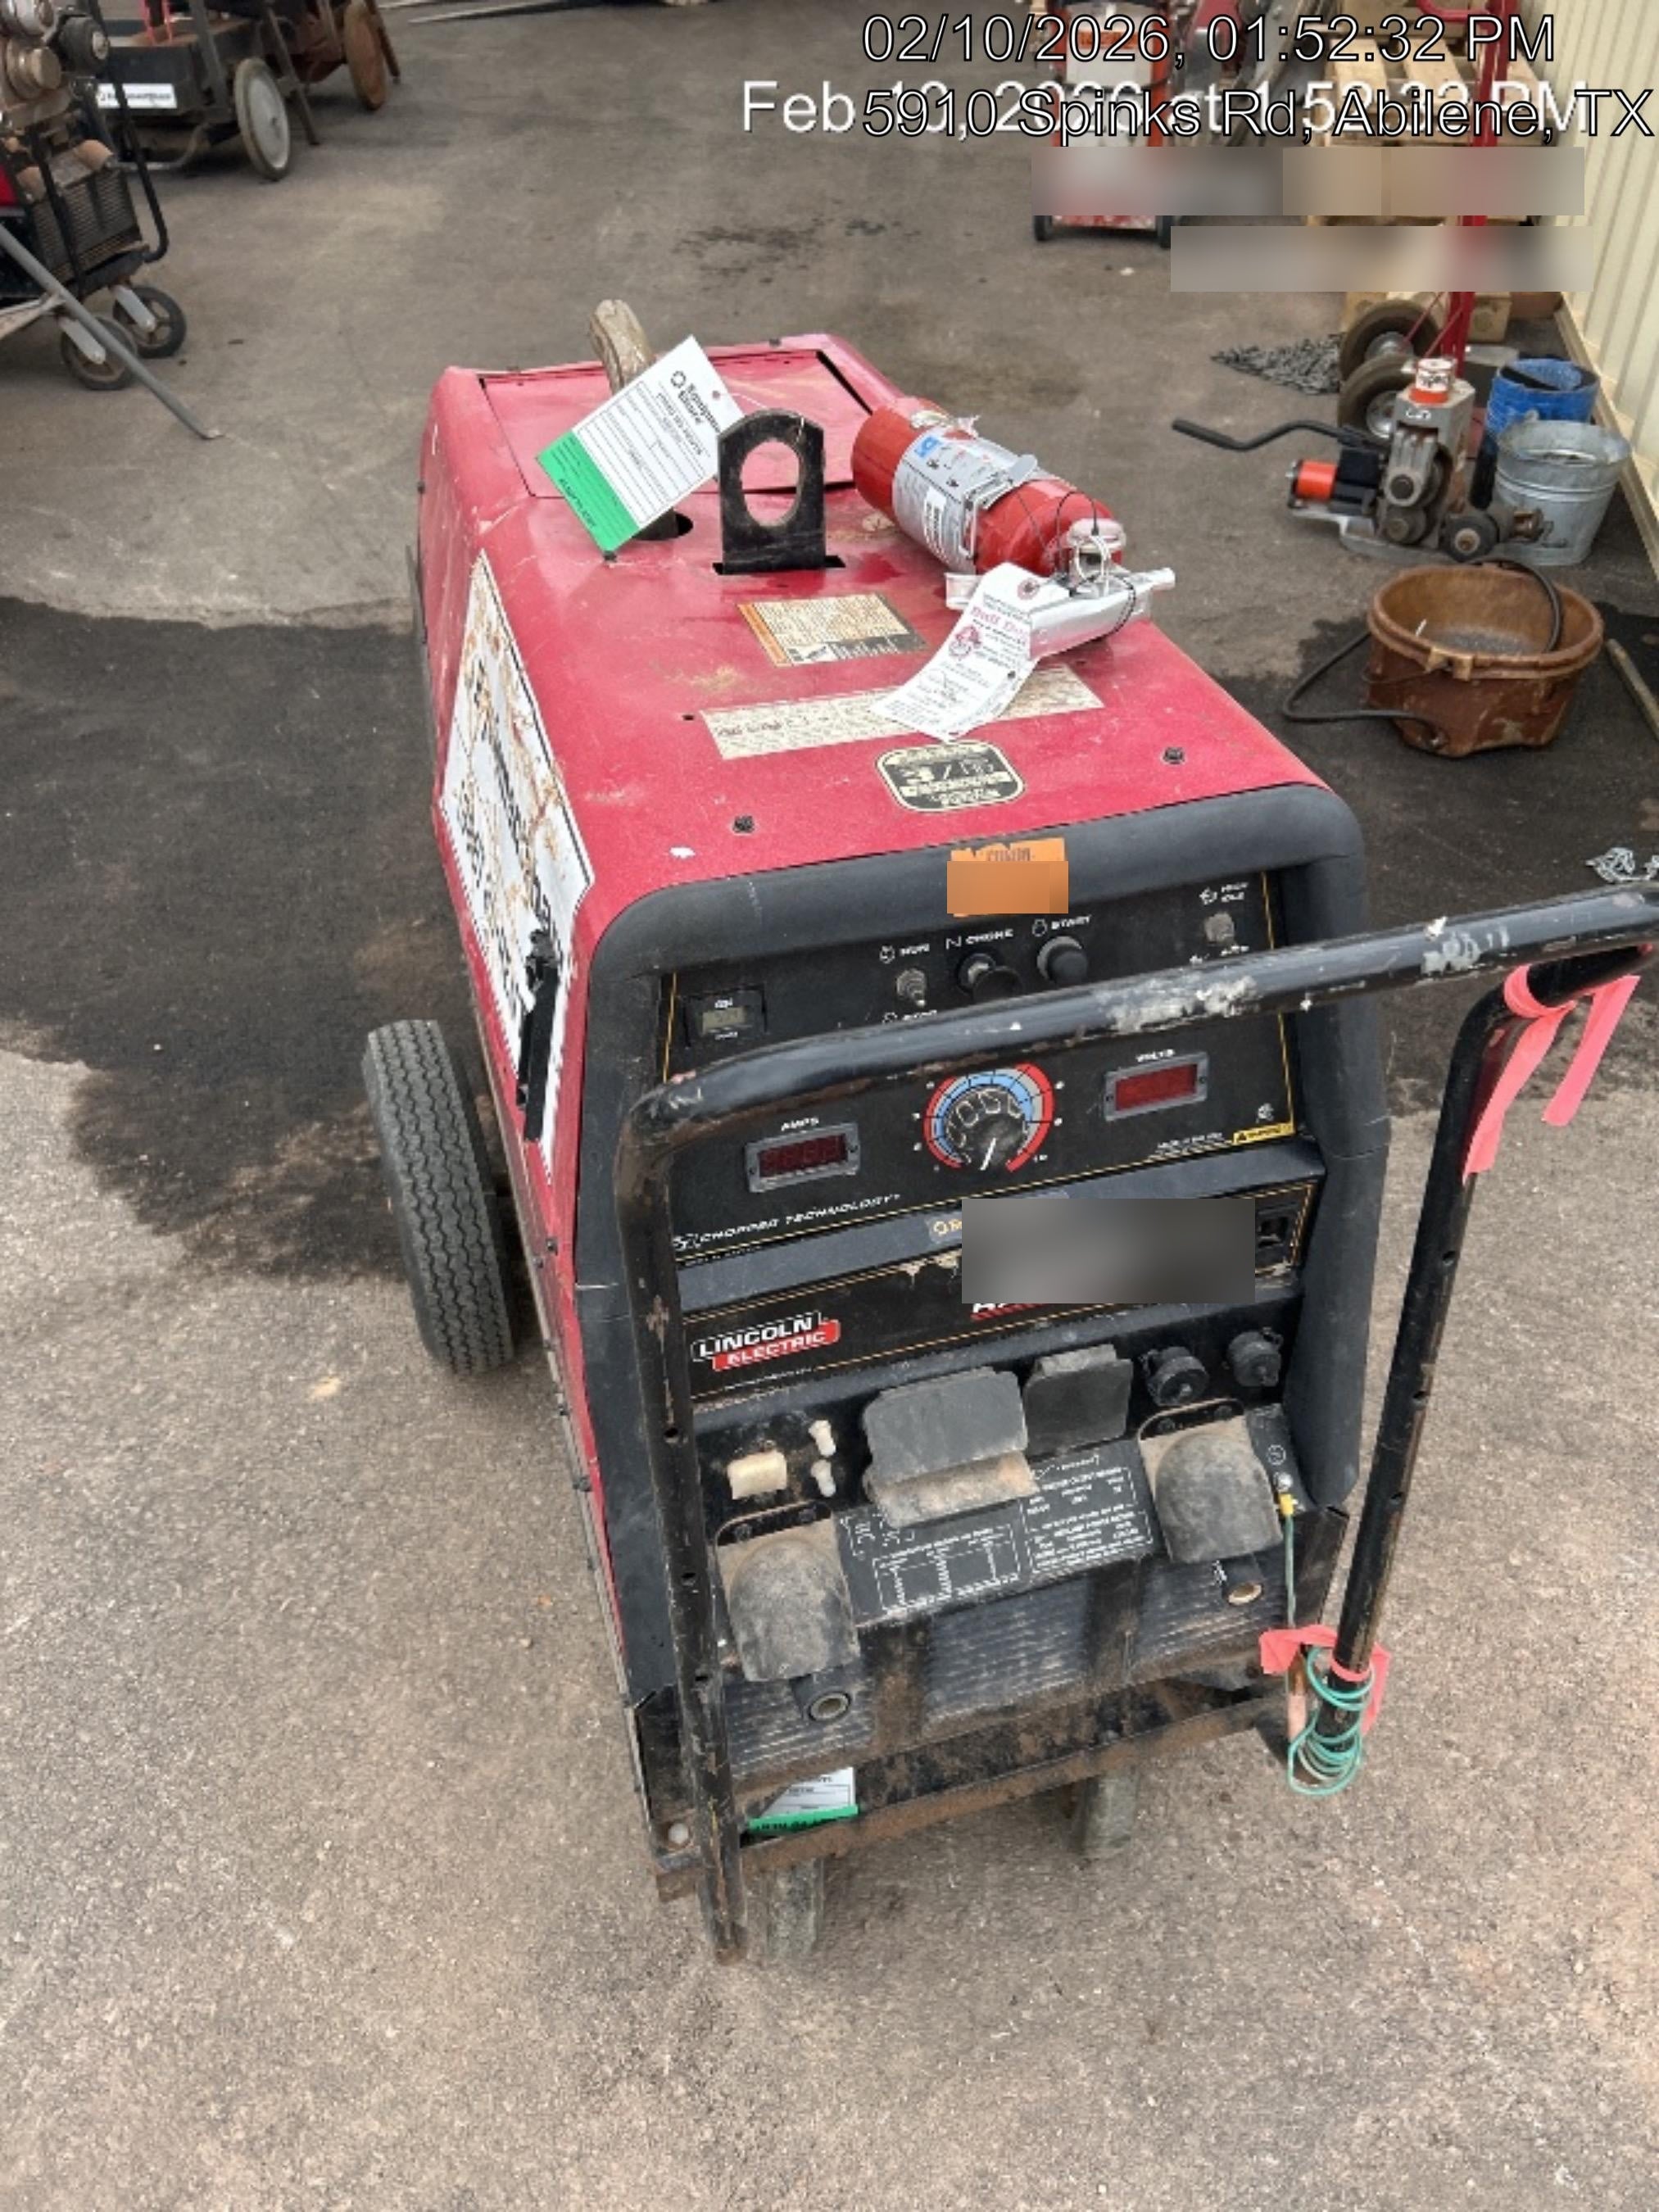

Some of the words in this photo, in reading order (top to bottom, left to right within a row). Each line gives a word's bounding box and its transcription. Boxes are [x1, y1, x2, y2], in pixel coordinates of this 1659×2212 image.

[780, 1117, 819, 1131] AMPS
[699, 1316, 813, 1357] LINCOLN
[726, 1330, 827, 1367] ELECTRIC
